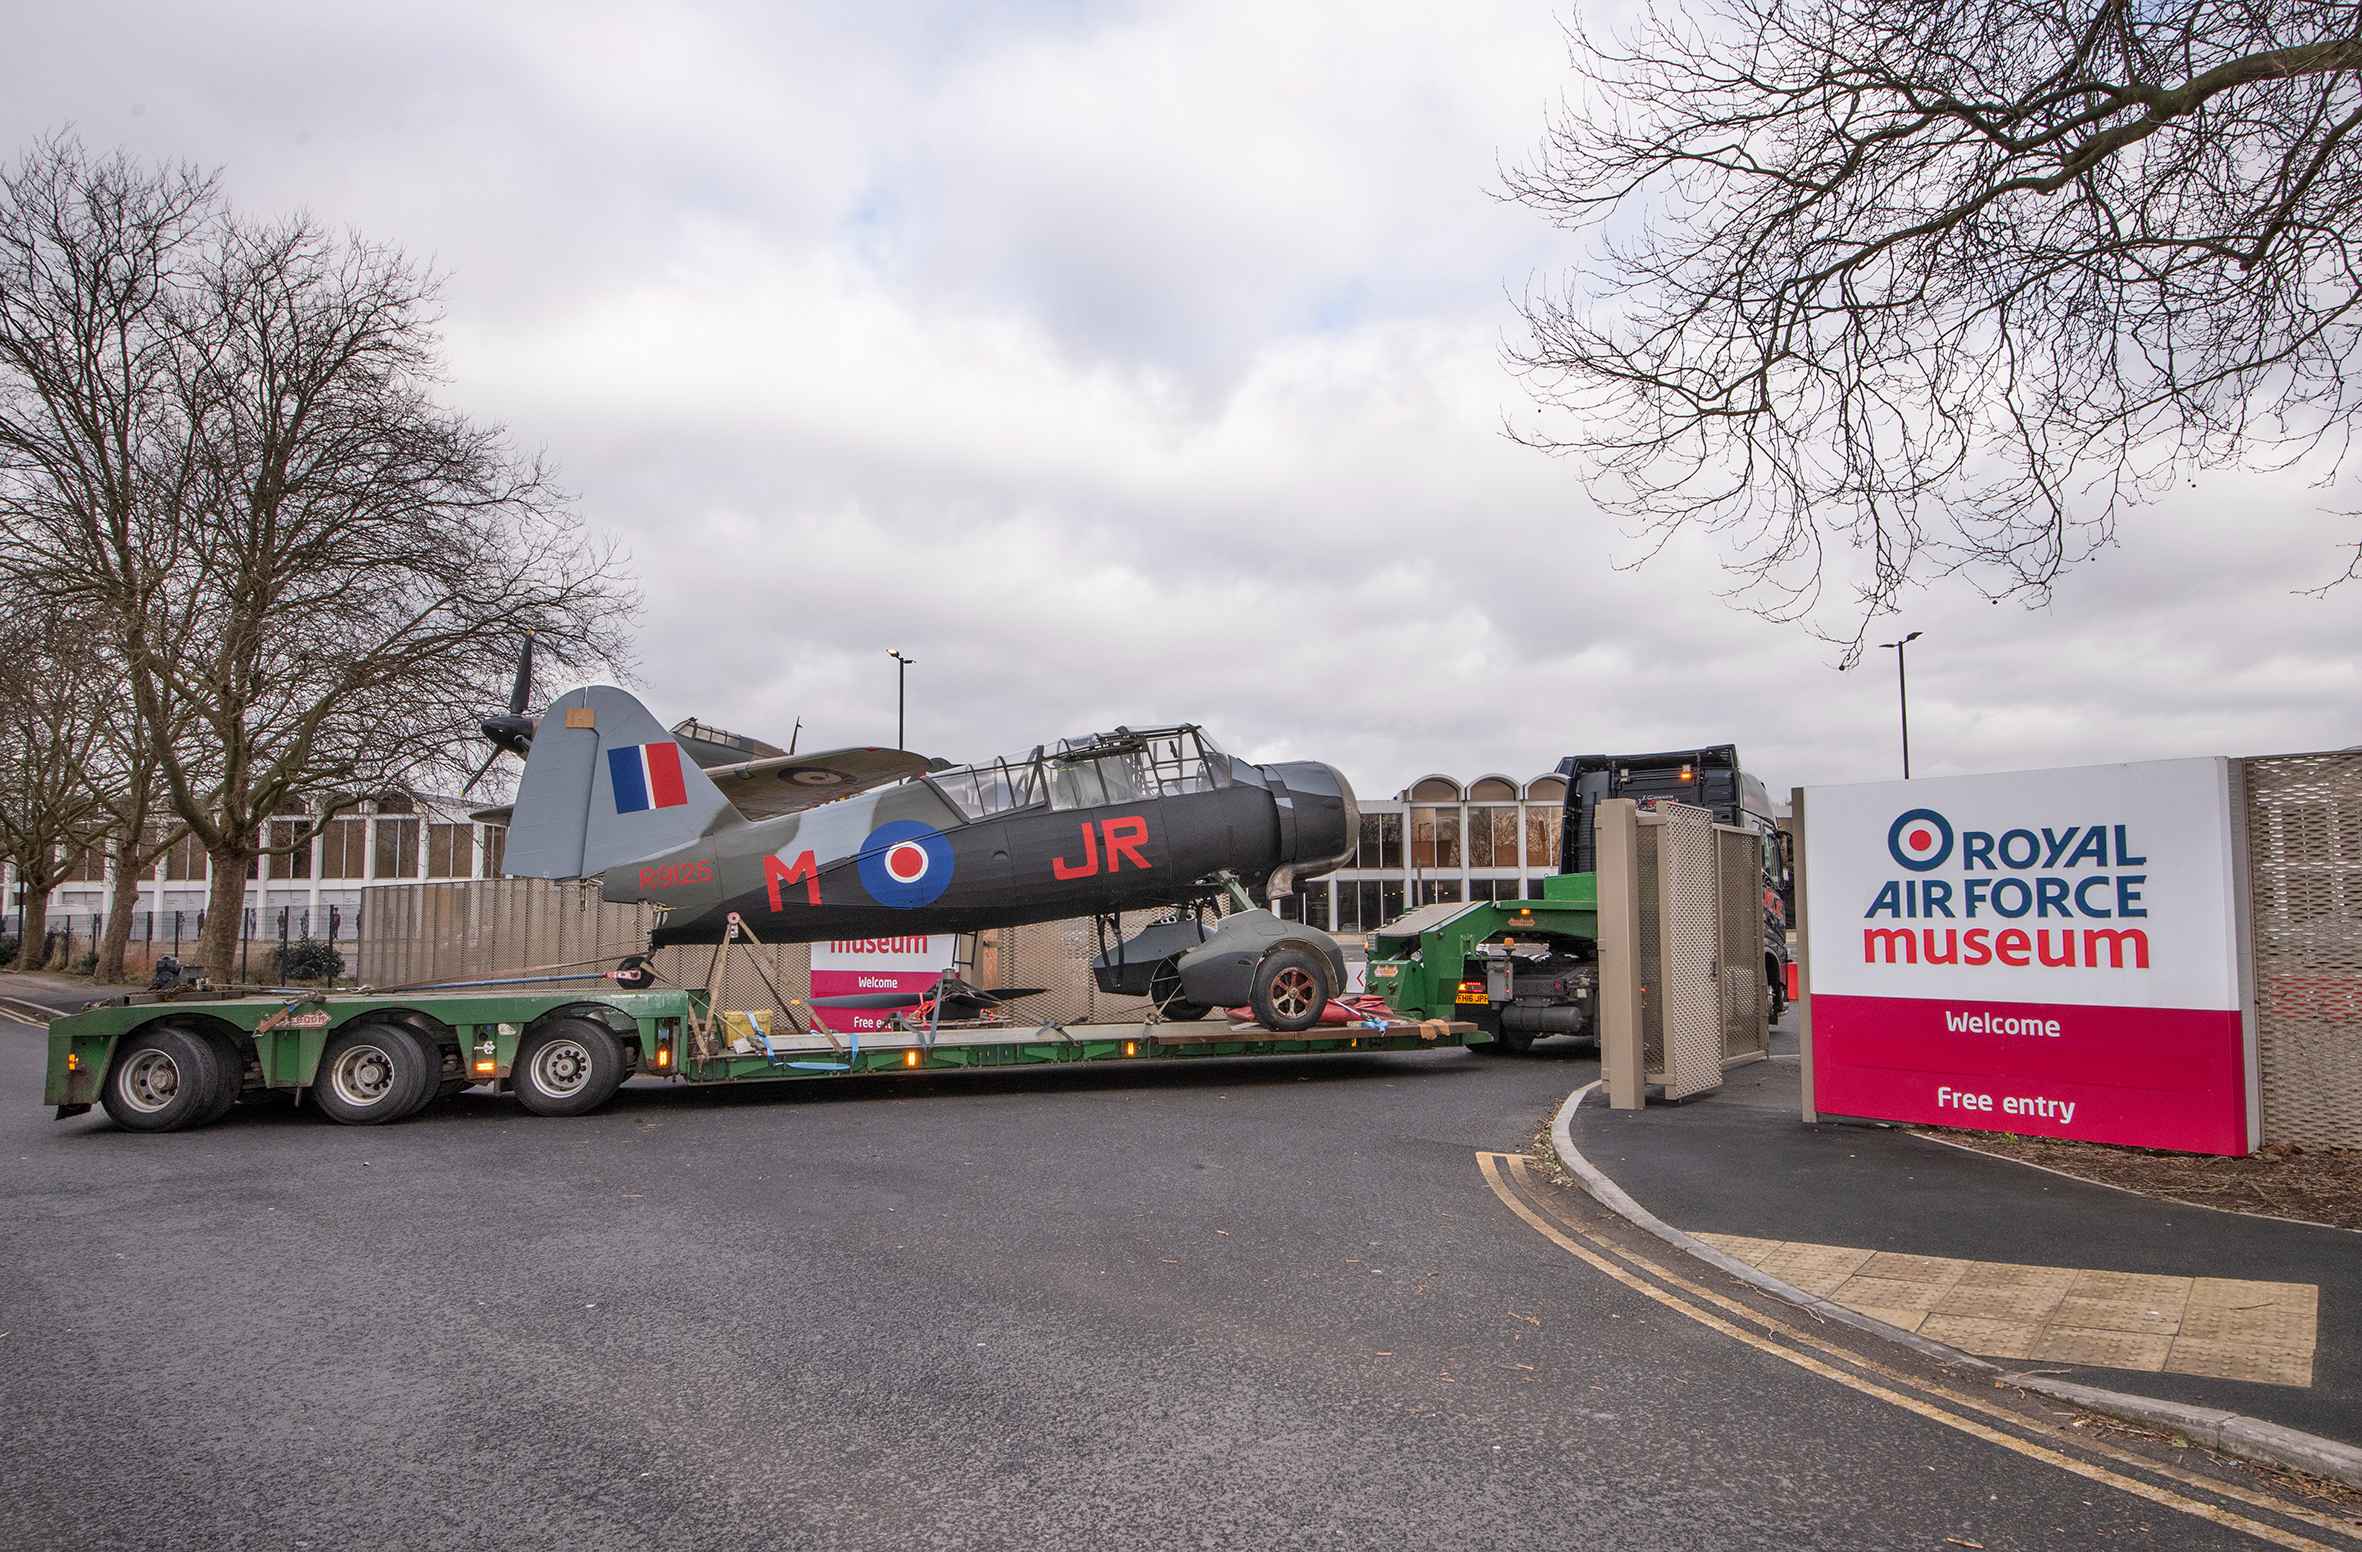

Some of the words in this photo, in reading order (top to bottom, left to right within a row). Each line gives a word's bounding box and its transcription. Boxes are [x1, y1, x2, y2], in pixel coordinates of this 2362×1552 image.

[1051, 815, 1152, 880] JR
[1962, 824, 2147, 870] ROYAL
[763, 848, 821, 912] M
[1864, 879, 1956, 918] AIR
[1964, 875, 2147, 918] FORCE
[830, 935, 928, 954] museum
[1864, 928, 2150, 968] museum
[858, 976, 898, 989] Welcome
[853, 1016, 874, 1029] Free
[1945, 1010, 2061, 1037] Welcome
[1938, 1086, 1993, 1112] Free
[2002, 1096, 2075, 1124] entry
